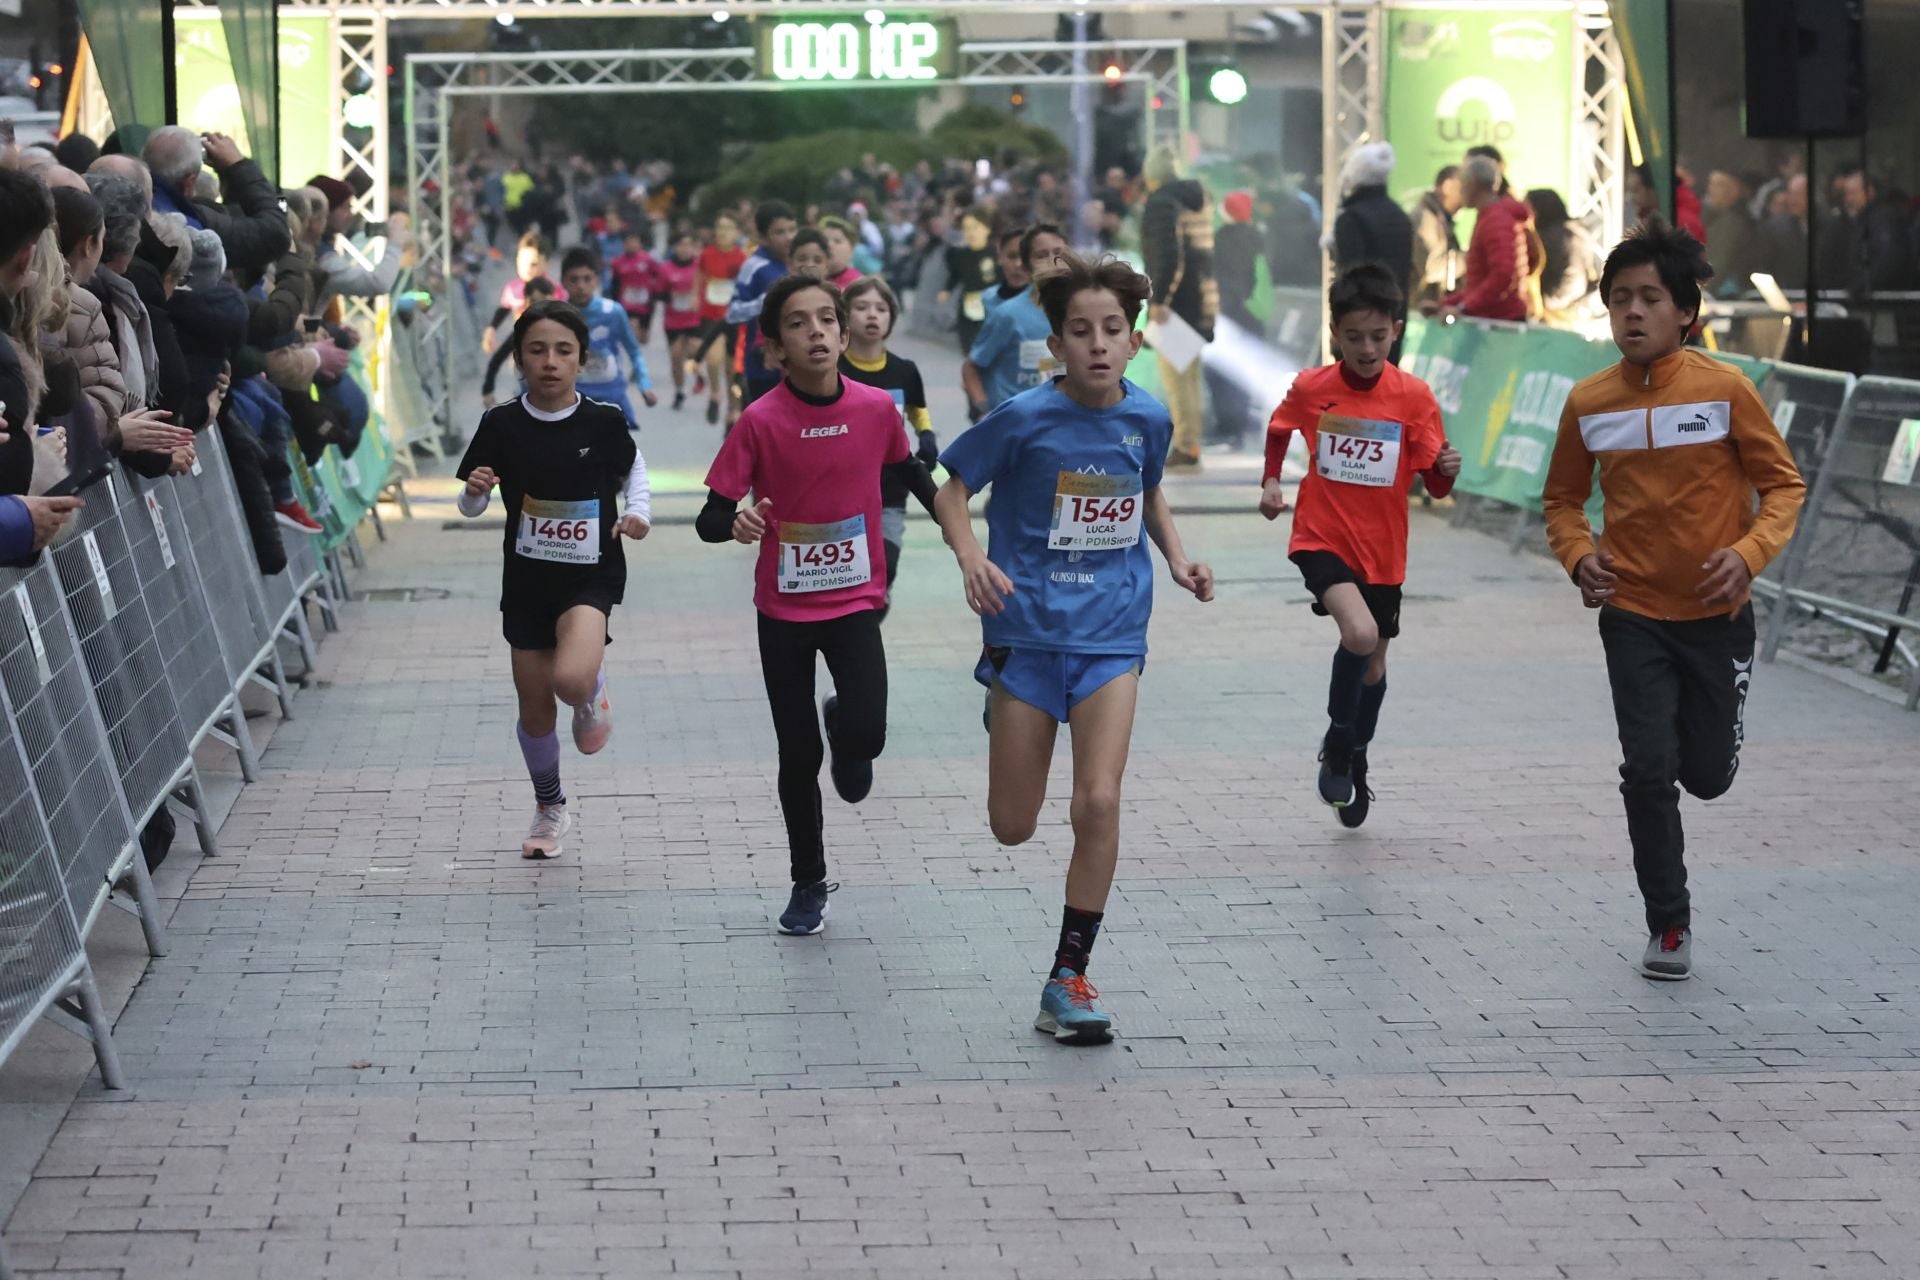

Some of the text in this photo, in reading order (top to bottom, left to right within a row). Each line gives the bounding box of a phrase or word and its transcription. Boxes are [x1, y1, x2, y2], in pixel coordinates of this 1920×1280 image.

[800, 424, 849, 439] LEGEA
[1677, 421, 1706, 433] PUMA
[1328, 435, 1384, 462] 1473
[1341, 460, 1366, 470] ILLAN
[1340, 471, 1386, 484] PDMSiero
[1071, 497, 1135, 523] 1549
[528, 517, 588, 541] 1466
[1086, 525, 1116, 533] LUCAS
[537, 539, 577, 550] RODRIGO
[1085, 536, 1132, 546] PDMSiero
[544, 549, 590, 561] PDMSiero
[791, 540, 855, 568] 1493
[796, 564, 853, 577] MARIO VIGIL
[812, 574, 862, 588] PDMSiero
